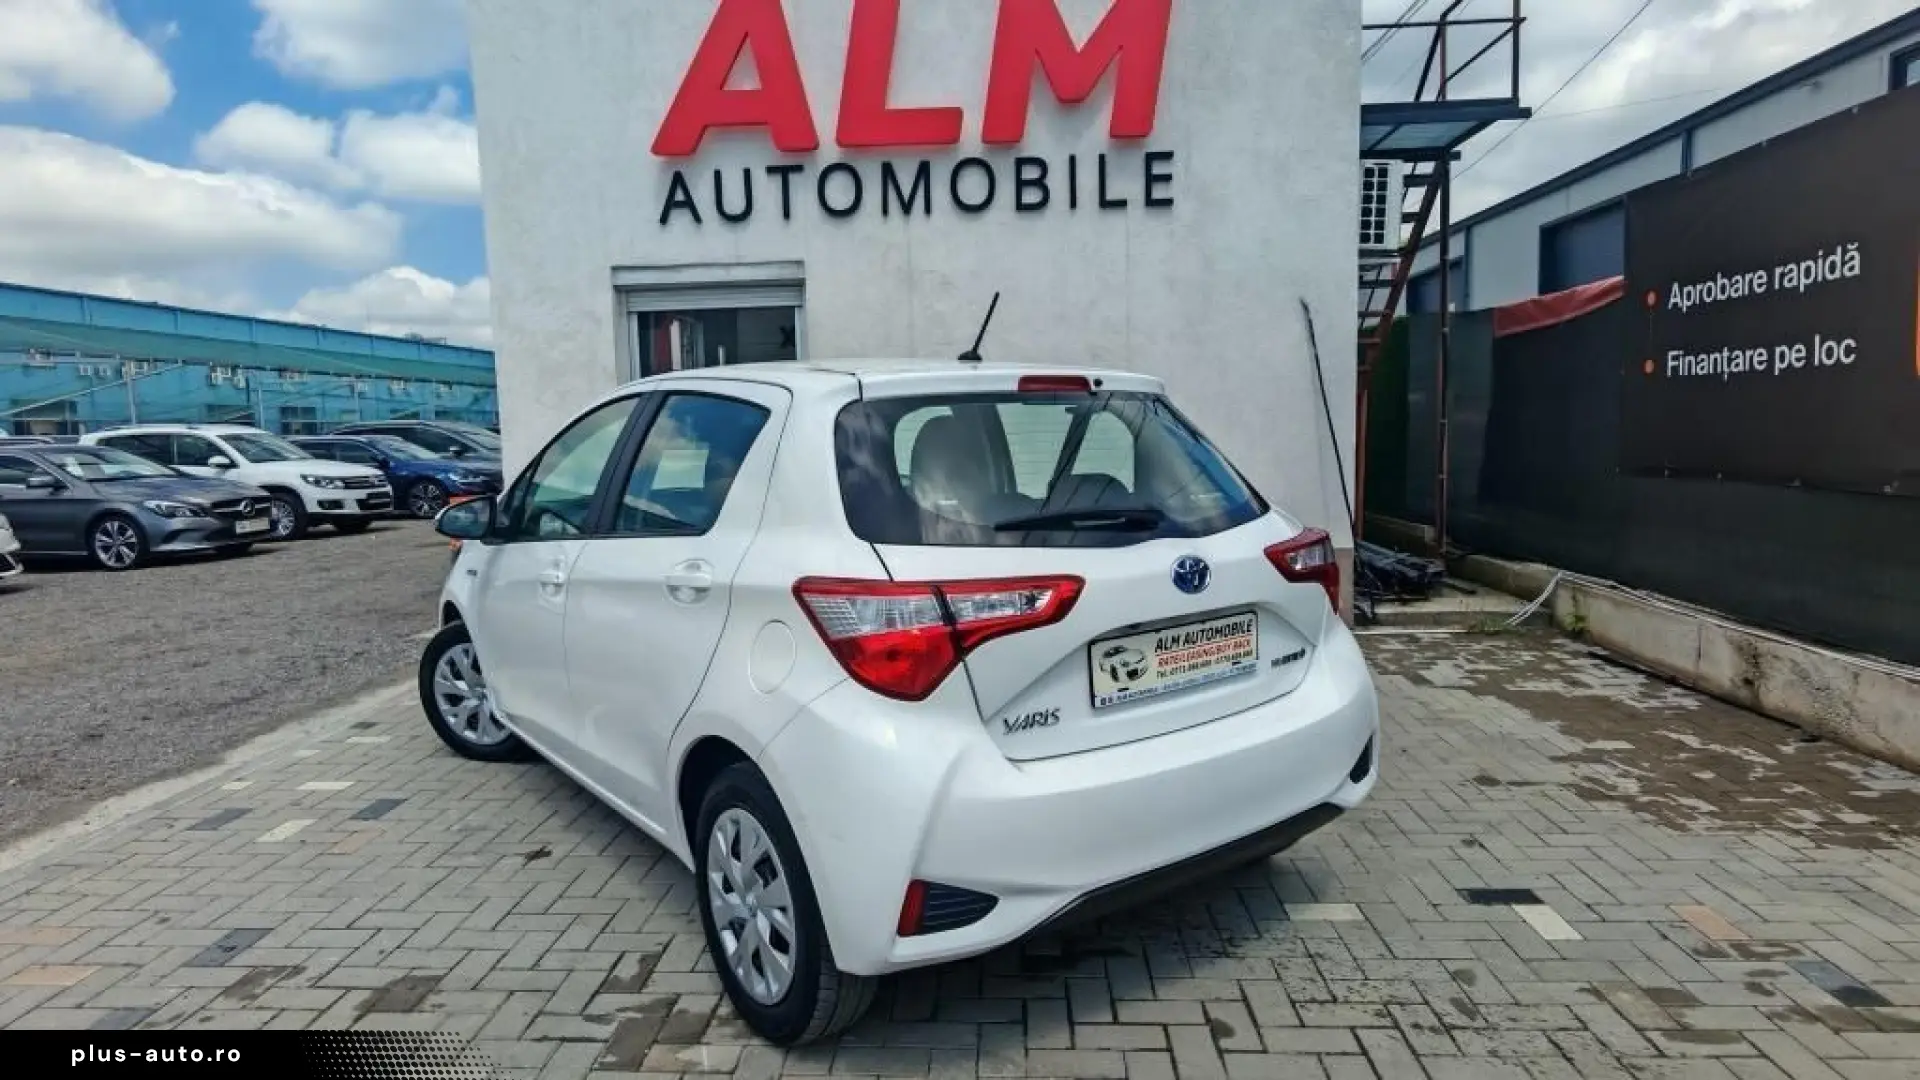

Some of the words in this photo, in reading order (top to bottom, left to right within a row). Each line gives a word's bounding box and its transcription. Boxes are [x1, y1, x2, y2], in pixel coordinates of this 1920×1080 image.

[651, 0, 1171, 156] ALM
[660, 151, 1174, 225] AUTOMOBILE
[1668, 271, 1767, 313] Aprobare
[1774, 242, 1861, 293] rapidă
[1667, 346, 1767, 380] Finanțare
[1774, 343, 1806, 375] pe
[1814, 334, 1857, 366] loc
[1155, 633, 1181, 653] ALM
[1182, 618, 1253, 648] AUTOMOBILE
[1002, 707, 1060, 735] YARIS
